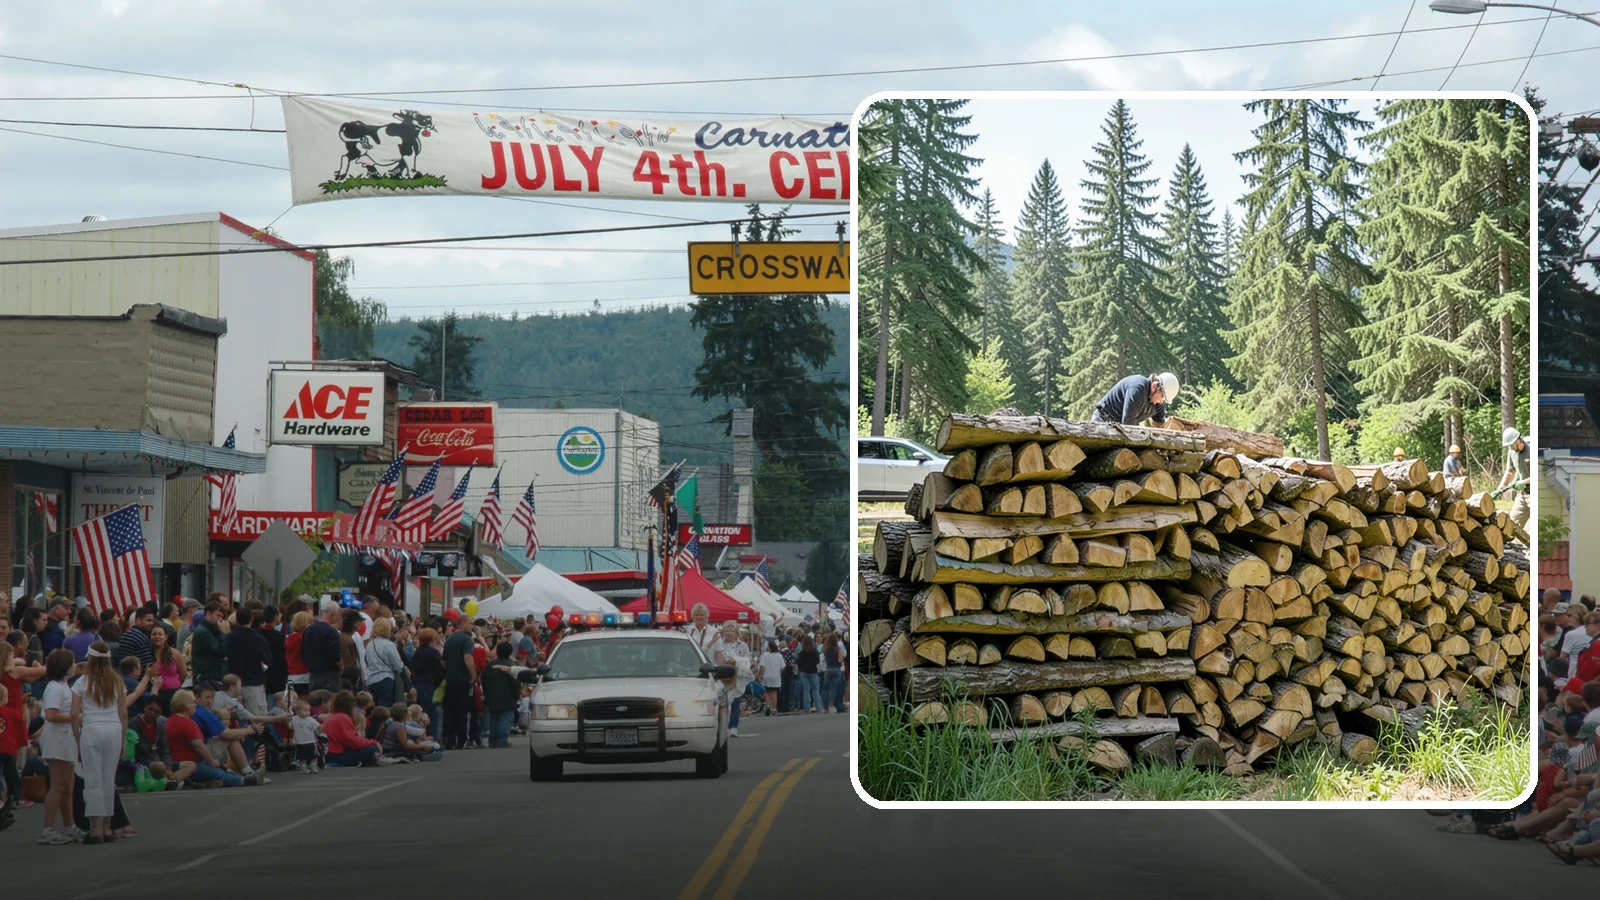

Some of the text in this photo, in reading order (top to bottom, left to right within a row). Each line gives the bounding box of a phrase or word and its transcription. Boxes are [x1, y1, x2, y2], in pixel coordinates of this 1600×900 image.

[694, 121, 850, 150] Carnat
[481, 141, 604, 192] JULY
[632, 150, 746, 198] 4th.
[697, 254, 850, 280] CROSSWA
[283, 380, 373, 420] ACE
[405, 409, 453, 422] CEDAR
[283, 421, 370, 436] Hardware
[416, 428, 476, 447] Coca-Cola
[353, 467, 386, 482] Simpl
[95, 485, 124, 495] Vincent
[126, 486, 135, 495] de
[137, 486, 155, 495] Paul
[688, 526, 741, 535] CRNATION
[699, 535, 730, 543] GLASS
